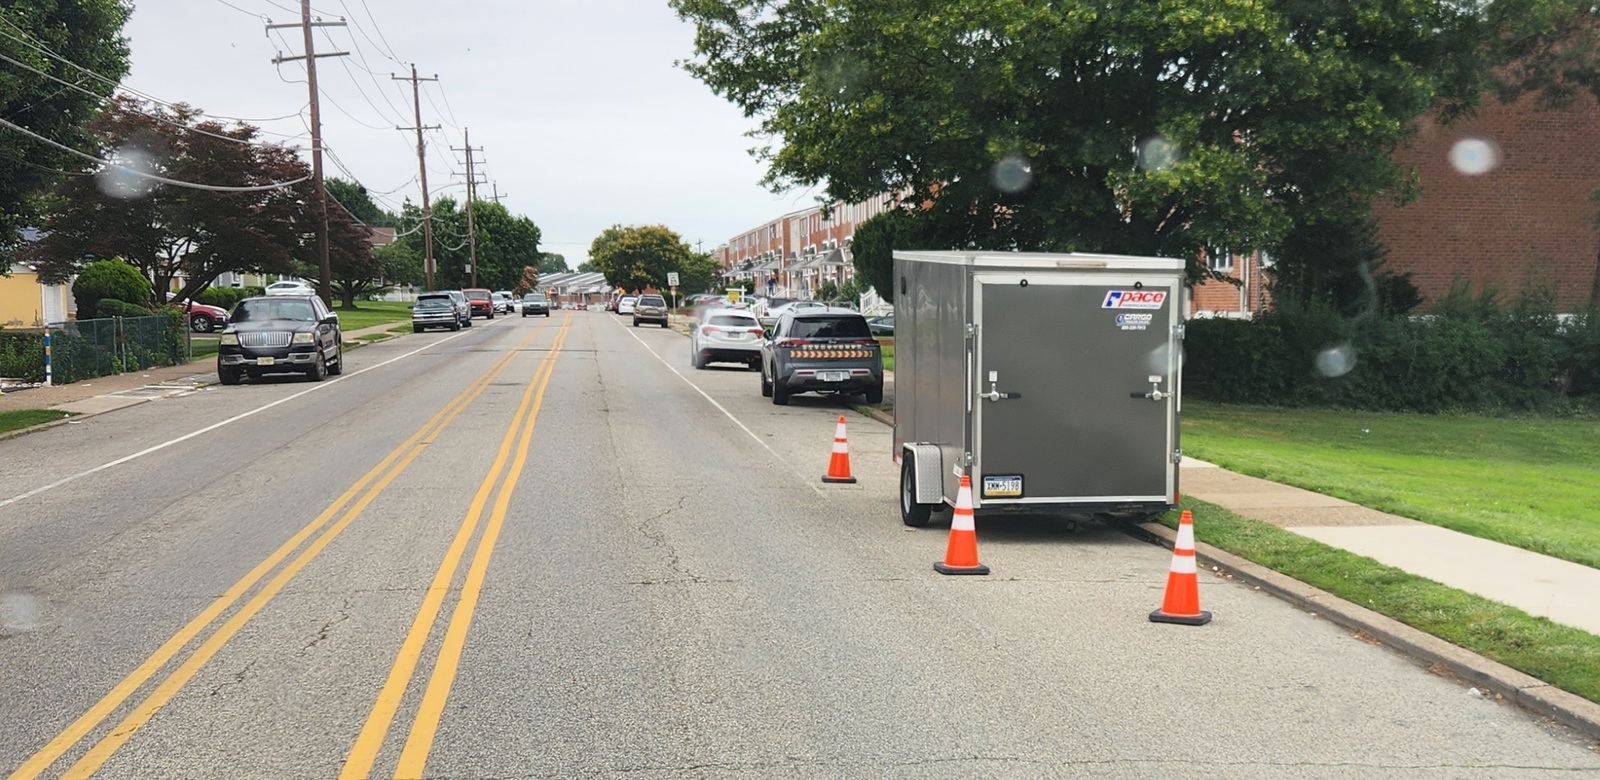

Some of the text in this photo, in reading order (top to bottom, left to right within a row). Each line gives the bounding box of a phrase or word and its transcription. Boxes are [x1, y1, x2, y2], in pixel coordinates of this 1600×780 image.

[1118, 292, 1164, 307] pace
[1124, 313, 1152, 321] CARGO
[986, 481, 1020, 491] XMM-5198
